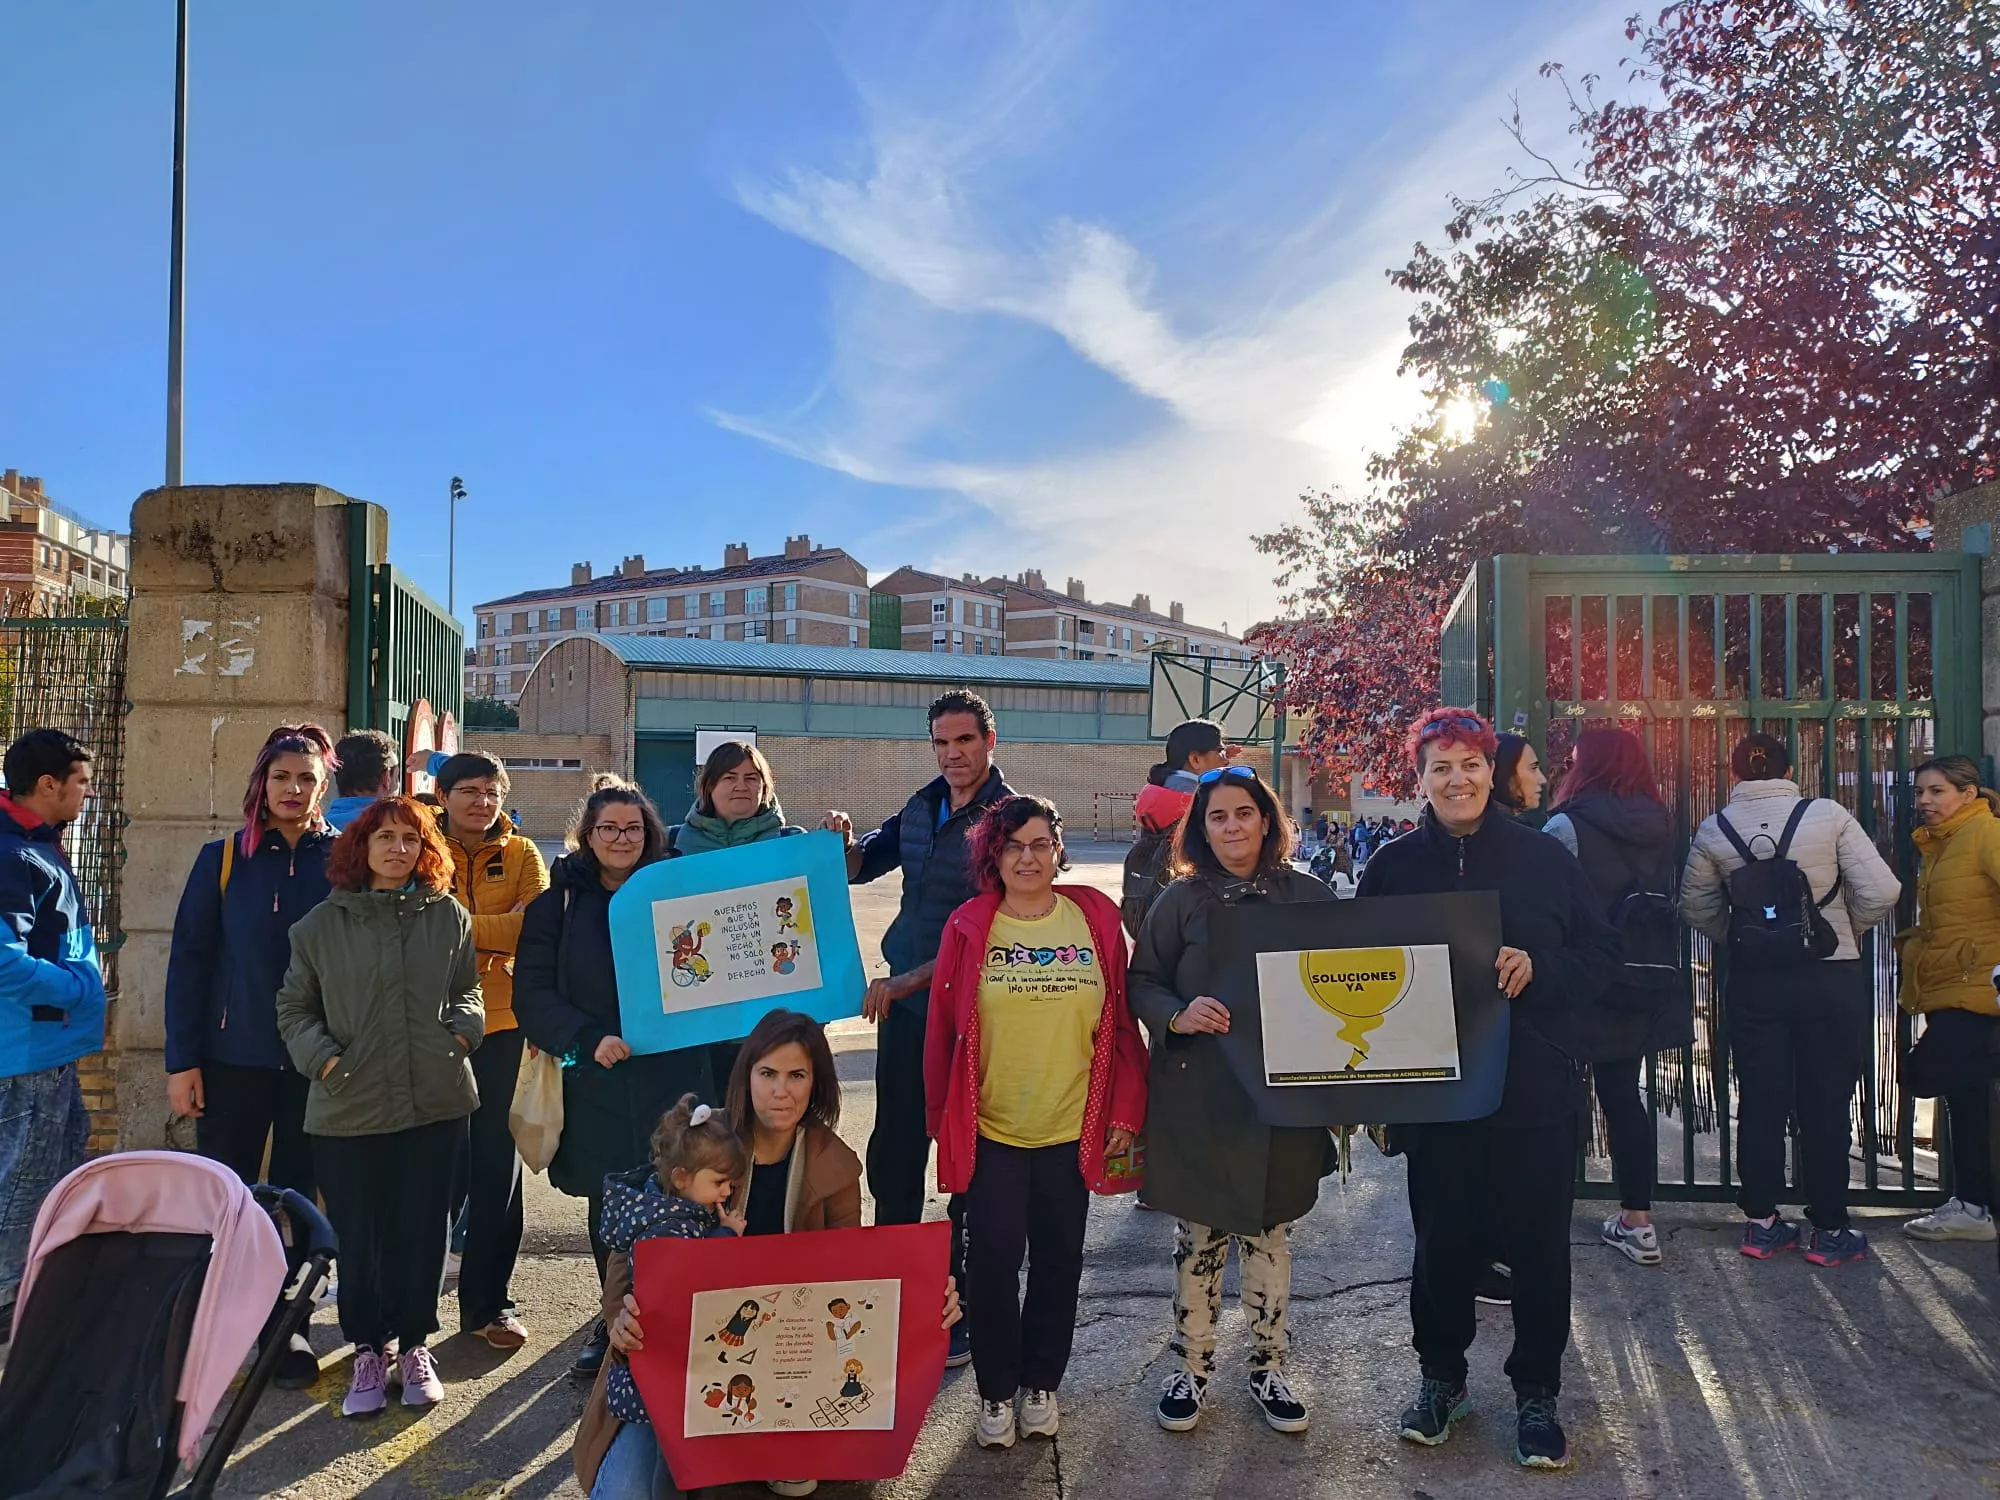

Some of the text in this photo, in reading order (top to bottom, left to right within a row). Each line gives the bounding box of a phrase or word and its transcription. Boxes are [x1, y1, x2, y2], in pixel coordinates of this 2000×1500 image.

[714, 901, 758, 916] QUEREMOS
[727, 914, 744, 923] QUE
[731, 930, 761, 942] SEA UN
[726, 939, 762, 951] HECHO Y
[730, 949, 763, 961] NO SOLO
[990, 948, 1090, 963] ACNEE
[754, 958, 765, 966] UN
[728, 968, 766, 980] DERECHO
[1312, 971, 1397, 984] SOLUCIONES
[1042, 984, 1078, 994] DERECHO!
[1346, 983, 1365, 992] YA
